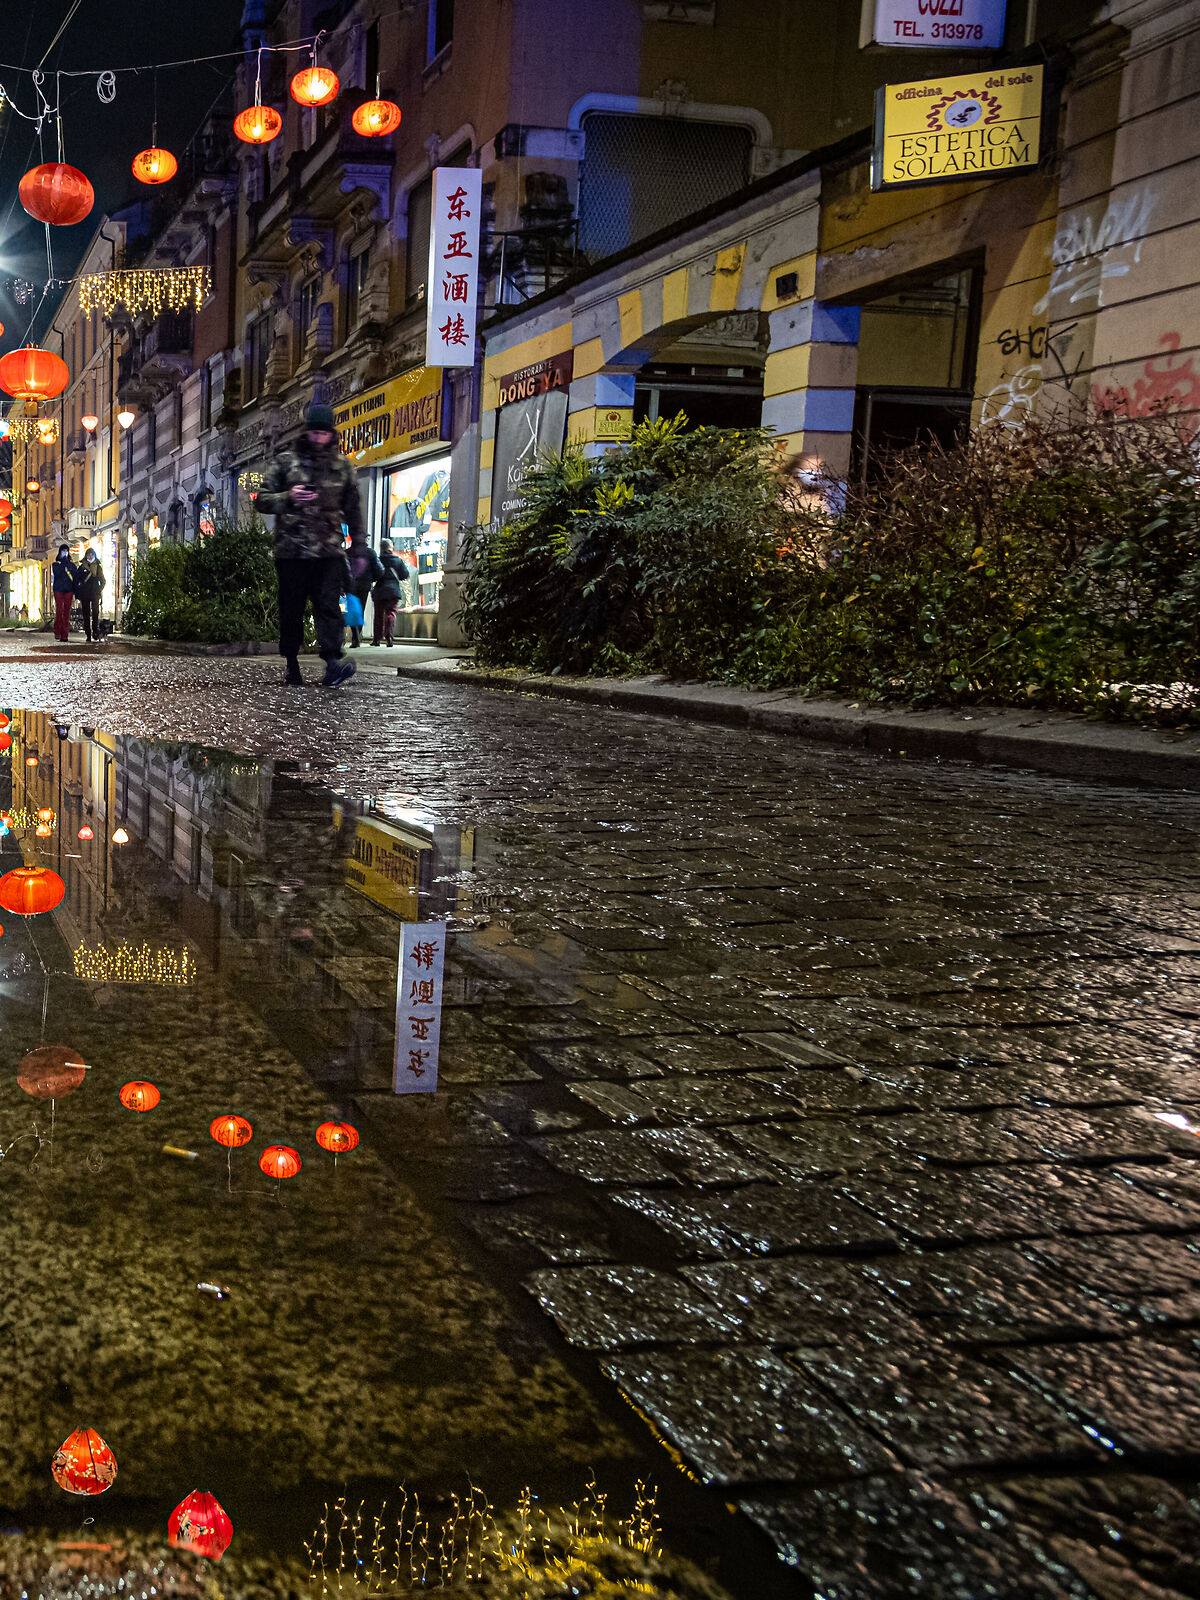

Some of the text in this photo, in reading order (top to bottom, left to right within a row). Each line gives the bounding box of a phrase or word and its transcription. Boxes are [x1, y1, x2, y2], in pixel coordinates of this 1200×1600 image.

[893, 20, 984, 40] TEL. 313978
[895, 73, 1034, 101] officina del sole
[900, 123, 1026, 159] ESTETICA
[892, 143, 1032, 180] SOLARIUM
[438, 186, 473, 348] 东亚酒楼
[500, 368, 563, 406] DONG YA
[513, 361, 554, 383] RISTORANTE
[393, 389, 440, 439] MARKET
[501, 498, 527, 512] COMING
